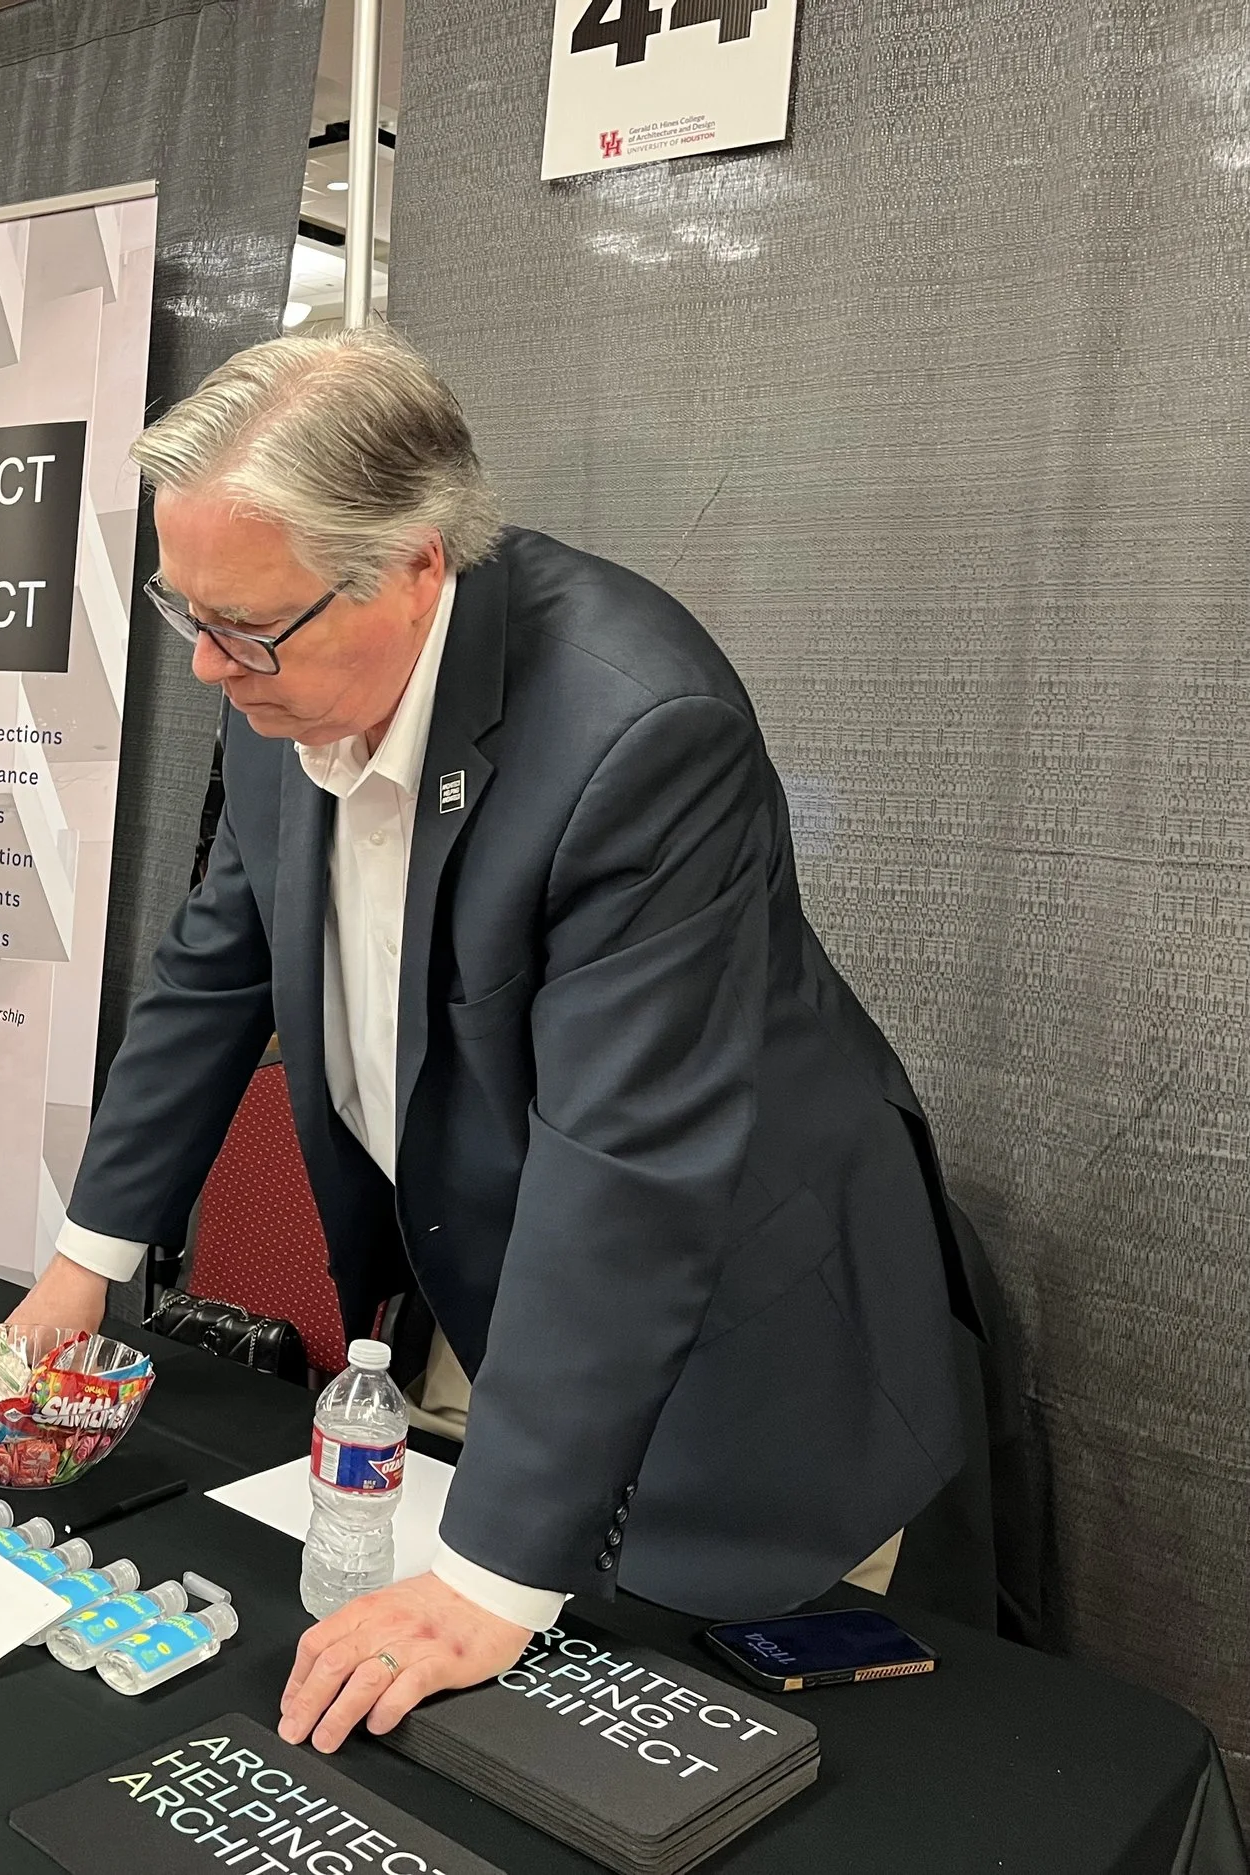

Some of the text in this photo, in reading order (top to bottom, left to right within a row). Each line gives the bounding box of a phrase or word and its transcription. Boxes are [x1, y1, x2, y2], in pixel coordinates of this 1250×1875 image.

[629, 124, 651, 135] Gerald
[660, 120, 679, 129] Hines
[679, 114, 705, 125] College
[637, 128, 677, 141] Architecture
[692, 120, 716, 131] Design
[627, 131, 716, 154] UNIVERSITY OF HOUSTON
[745, 1632, 797, 1665] 11:04
[541, 1626, 777, 1741] RCHITECT
[152, 1750, 354, 1875] HELPING
[188, 1736, 447, 1875] ARCHITEC
